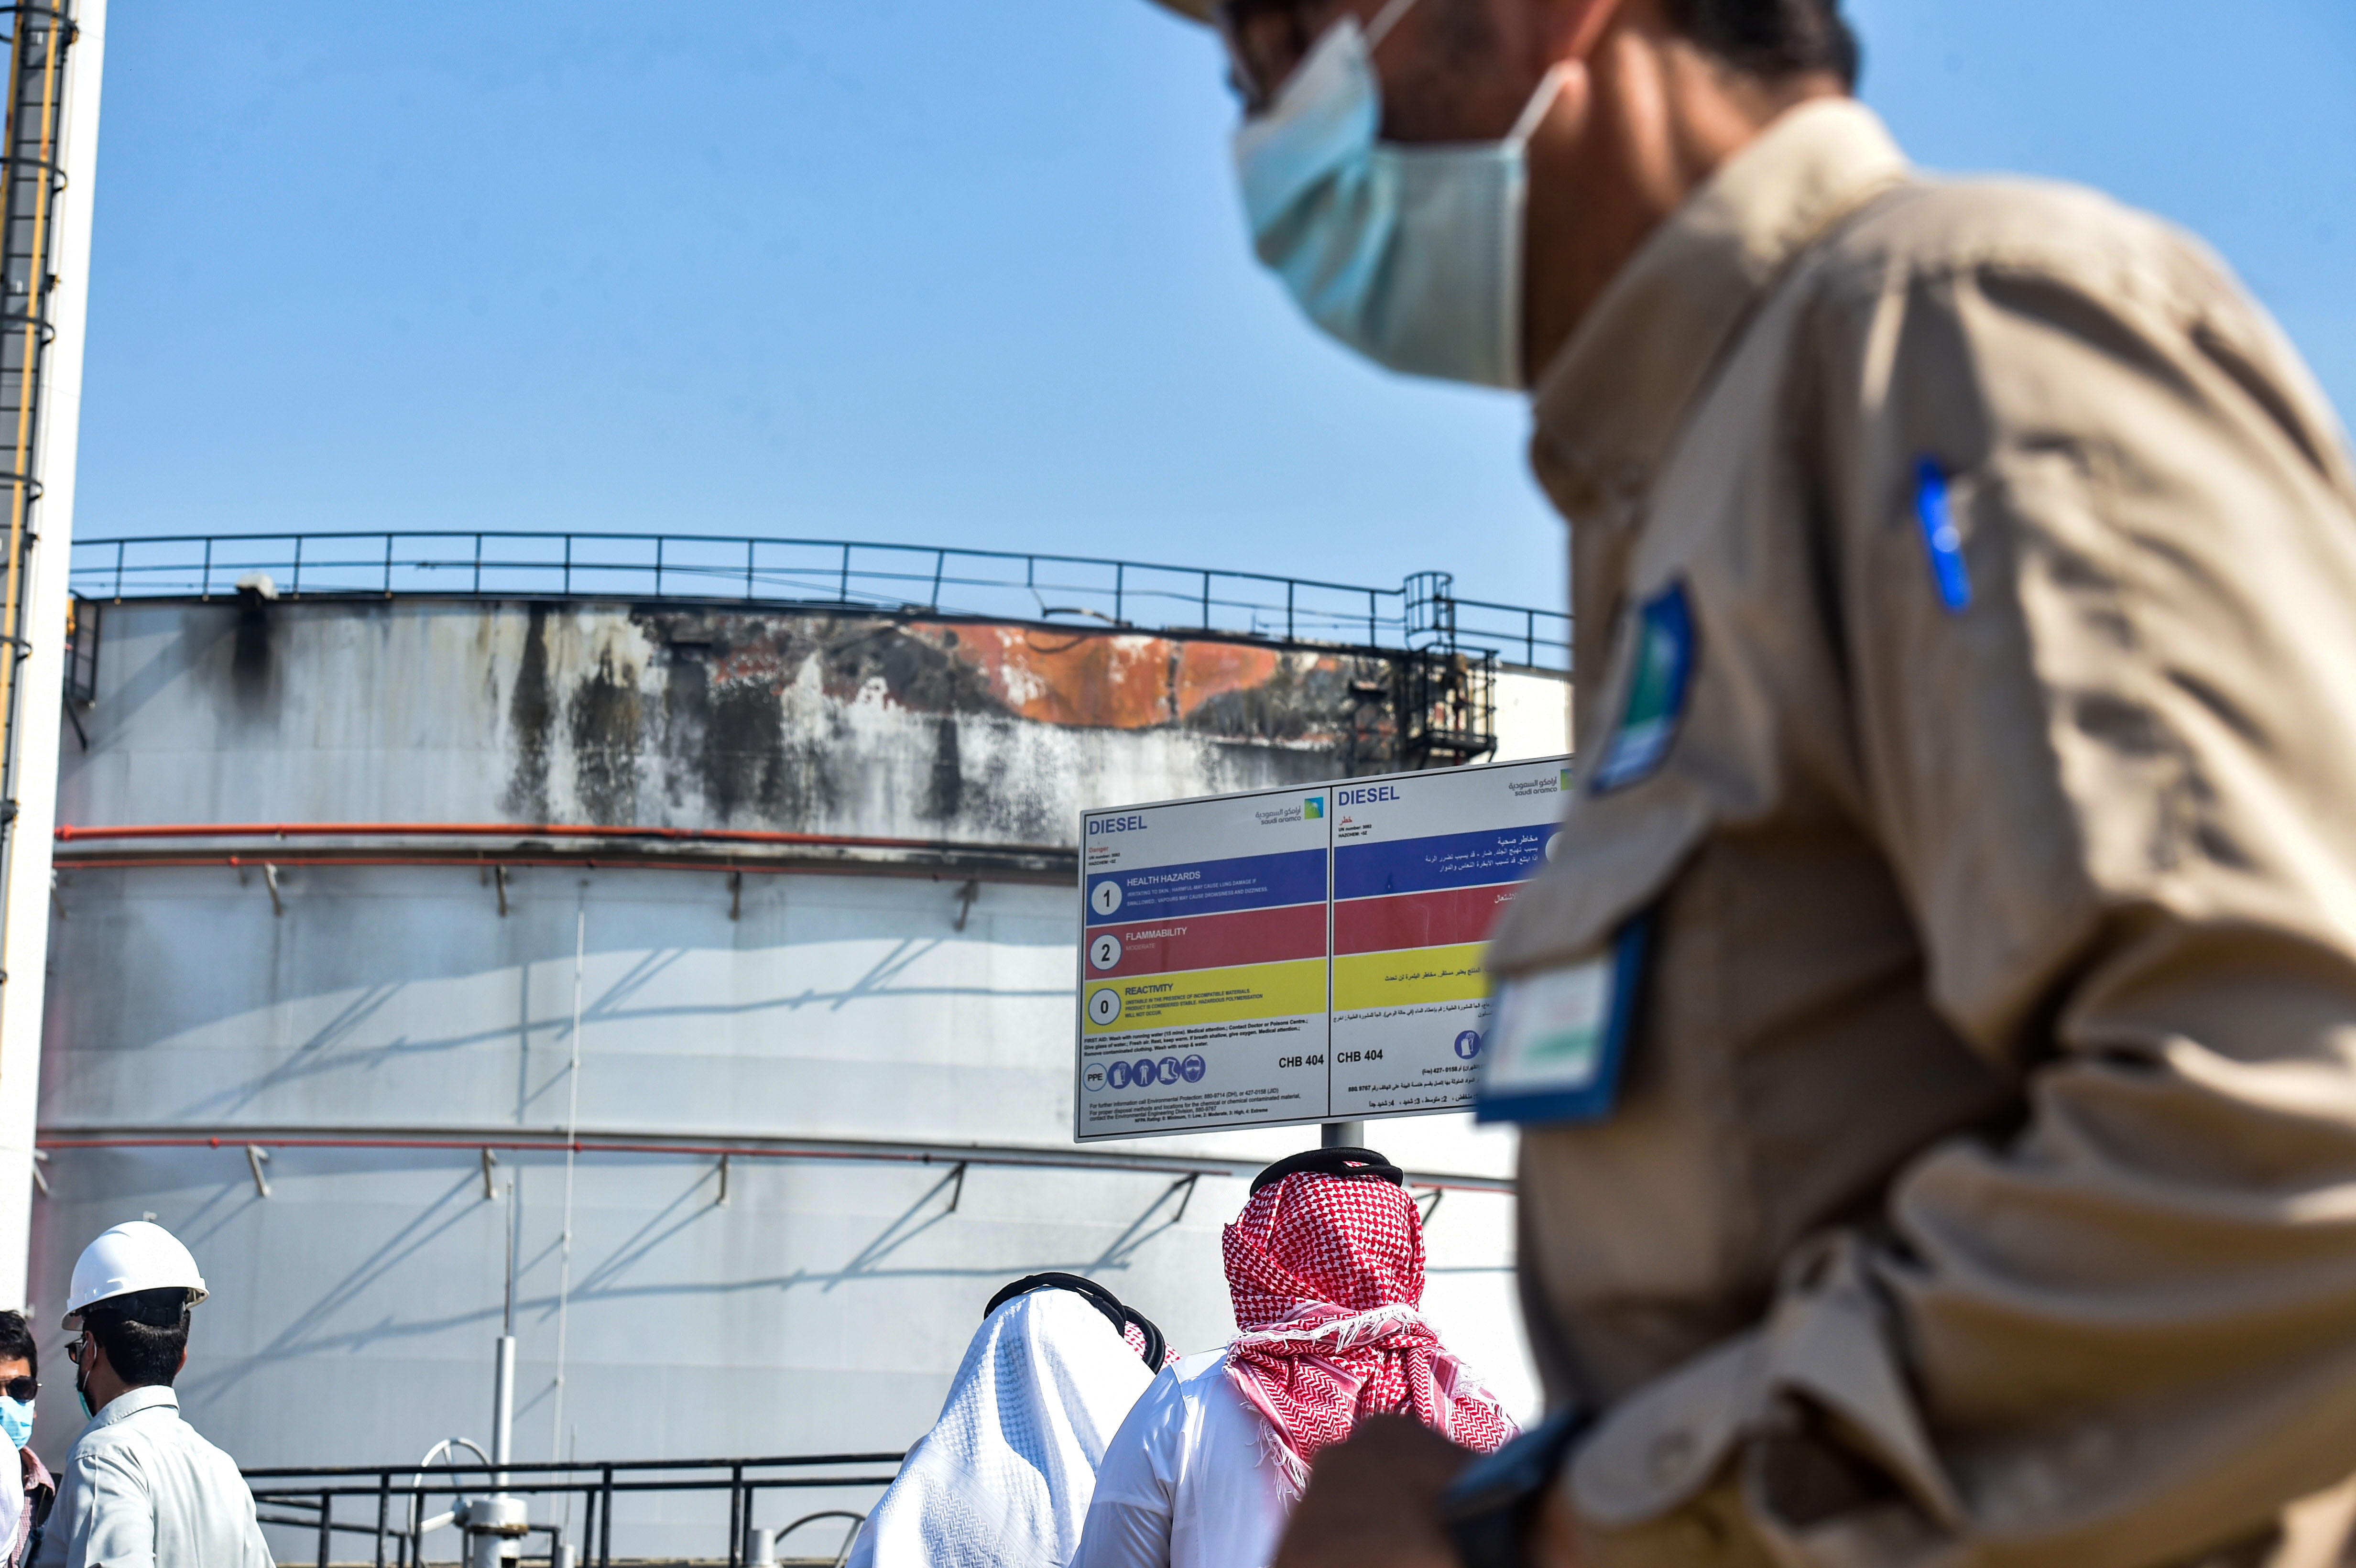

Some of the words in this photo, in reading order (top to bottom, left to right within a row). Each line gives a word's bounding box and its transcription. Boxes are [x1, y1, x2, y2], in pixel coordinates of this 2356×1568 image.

[1508, 780, 1538, 791] السعودية
[1339, 785, 1400, 806] DIESEL
[1090, 815, 1147, 835] DIESEL
[1339, 815, 1352, 825] خطر
[1497, 835, 1516, 847] صحية
[1519, 833, 1538, 844] مخاطر
[1089, 845, 1108, 854] Danger
[1127, 875, 1158, 886] HEALTH
[1161, 871, 1200, 882] HAZARDS
[1103, 889, 1109, 907] 1
[1125, 926, 1187, 941] FLAMMABILITY
[1102, 943, 1110, 961] 2
[1125, 943, 1155, 951] MODERATE
[1125, 983, 1173, 995] REACTIVITY
[1101, 1000, 1108, 1013] 0
[1279, 1056, 1302, 1068] CHB
[1305, 1054, 1324, 1066] 404
[1337, 1051, 1361, 1063] CHB
[1364, 1049, 1383, 1061] 404
[1088, 1073, 1103, 1081] PPE
[1147, 1096, 1178, 1104] Environmental
